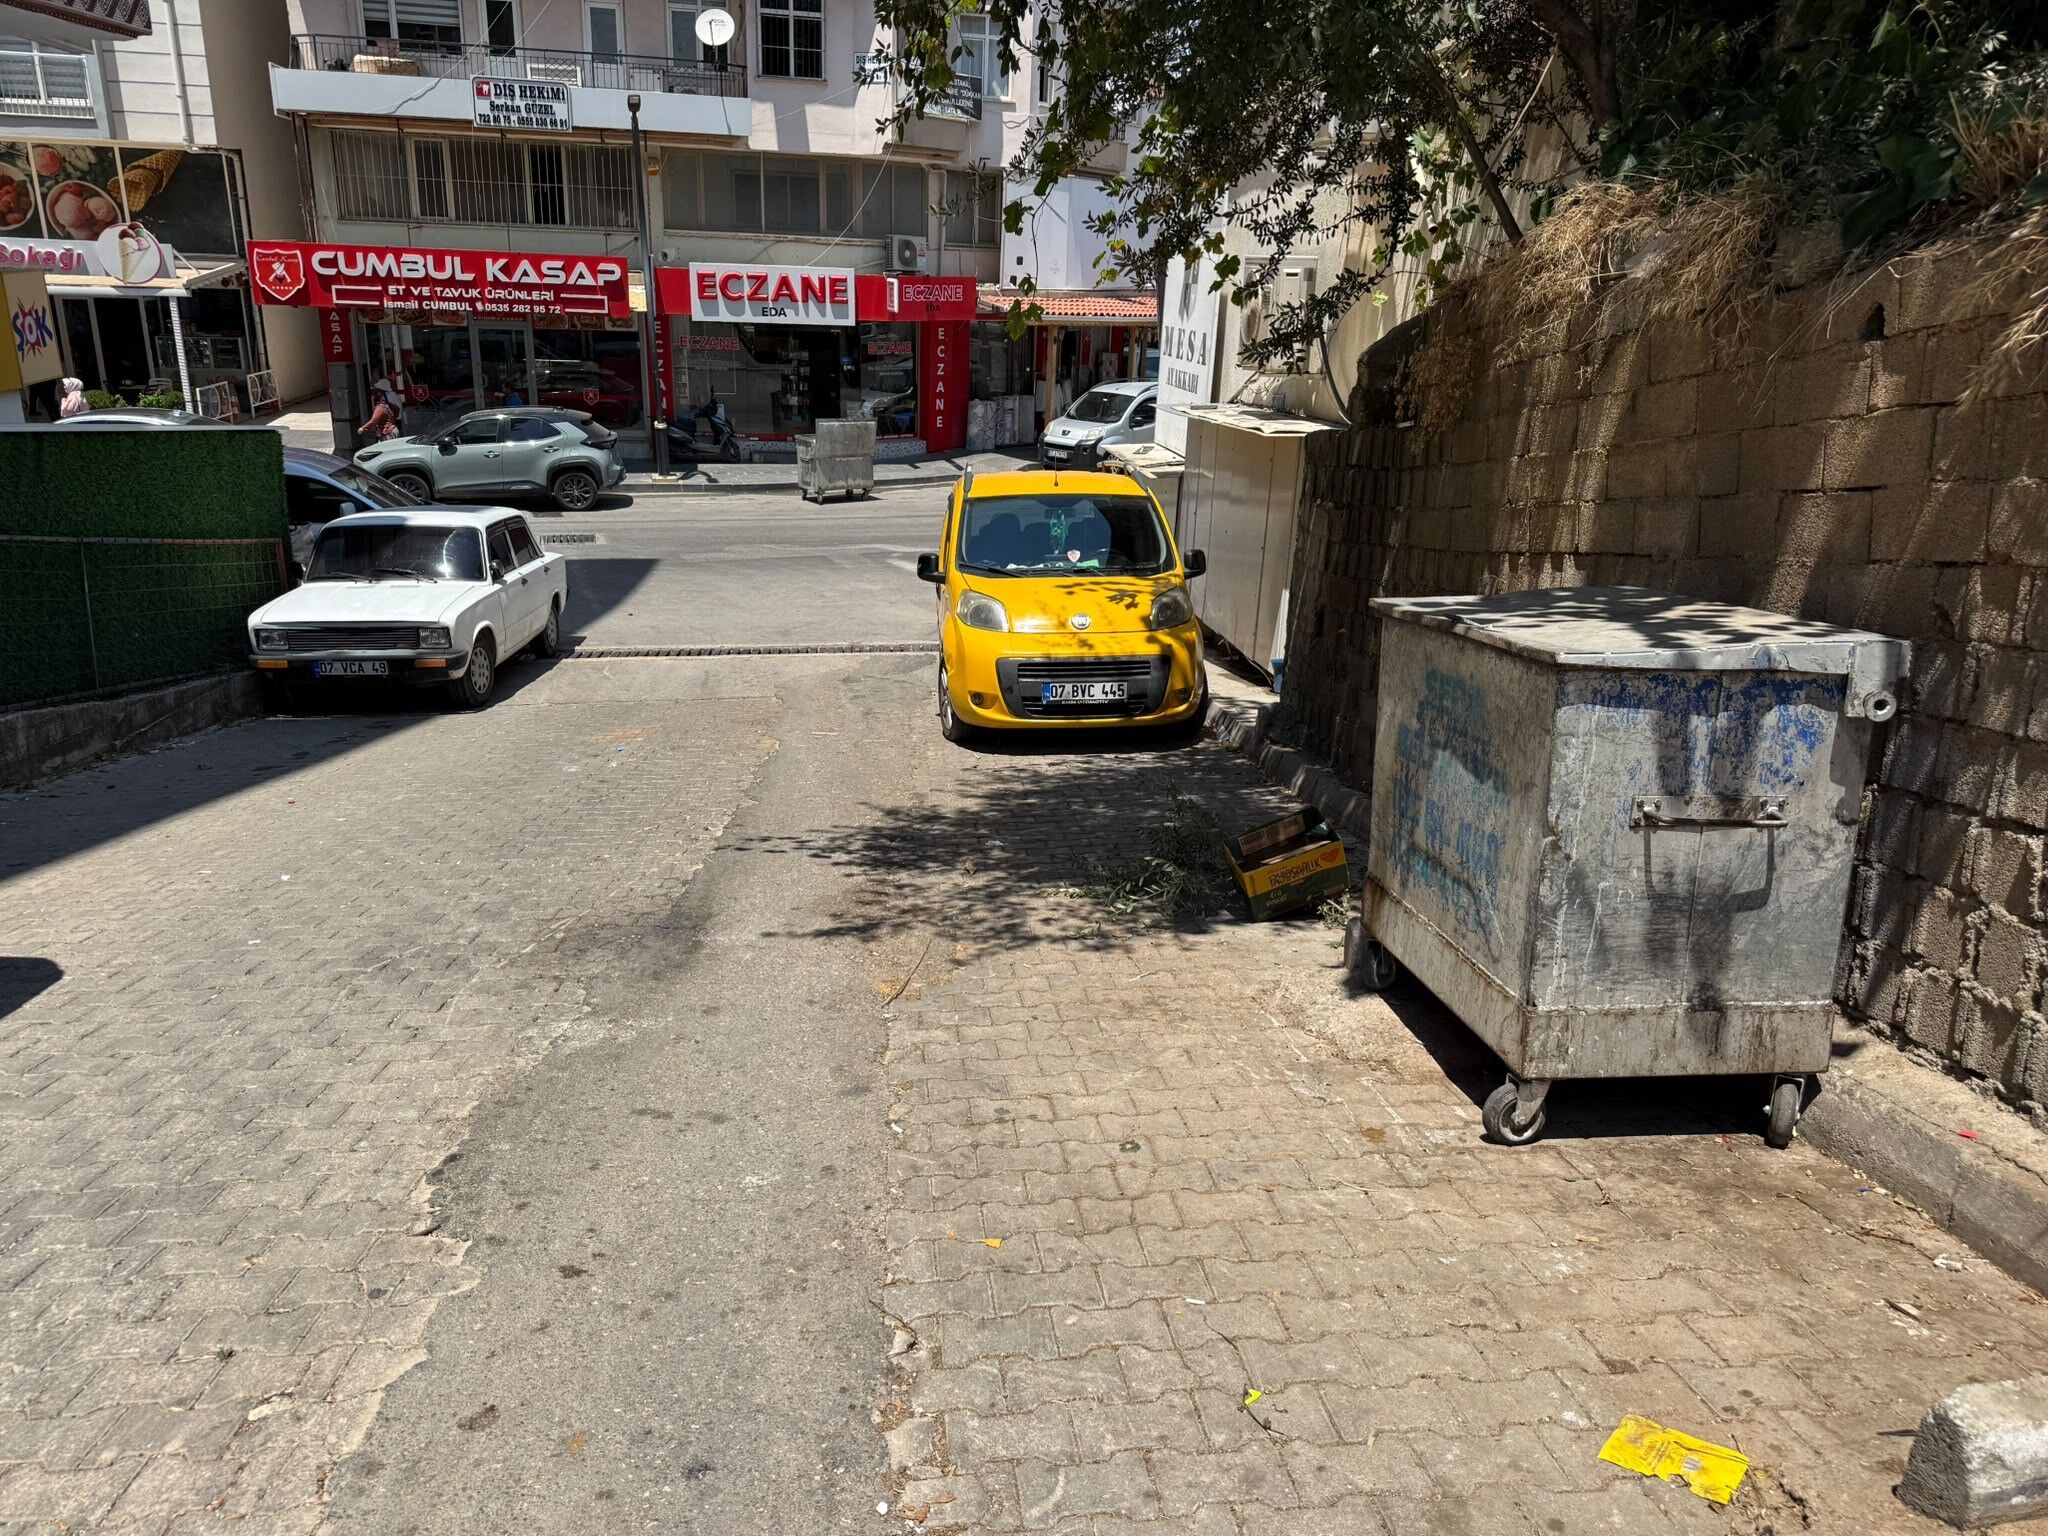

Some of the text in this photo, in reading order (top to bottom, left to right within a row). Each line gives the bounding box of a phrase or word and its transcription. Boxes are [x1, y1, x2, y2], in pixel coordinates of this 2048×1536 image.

[493, 81, 566, 101] DİŞ HEKİMİ
[489, 101, 556, 115] Serkan GÜZEL
[478, 114, 491, 123] 722
[503, 115, 511, 125] 75
[559, 119, 568, 128] 91
[311, 251, 622, 286] CUMBUL KASAP
[388, 285, 554, 301] ET VE TAVUK ÜRÜNLERİ
[697, 271, 849, 304] ECZANE
[903, 284, 963, 301] ECZANE
[422, 300, 473, 311] CUMBUL
[484, 303, 510, 312] 0535
[512, 304, 531, 313] 282
[533, 305, 546, 314] 95
[548, 305, 561, 314] 72
[761, 307, 787, 317] EDA
[329, 311, 343, 354] ASAP
[678, 335, 740, 350] ECZANE
[867, 341, 913, 355] ECZANE
[1163, 325, 1207, 366] MESA
[936, 327, 945, 428] ECZANE
[1165, 367, 1199, 395] AYAKKABI
[320, 662, 333, 673] 07
[341, 662, 365, 673] VCA
[1050, 684, 1066, 698] 07
[1071, 684, 1095, 698] BVC
[1101, 683, 1125, 698] 445
